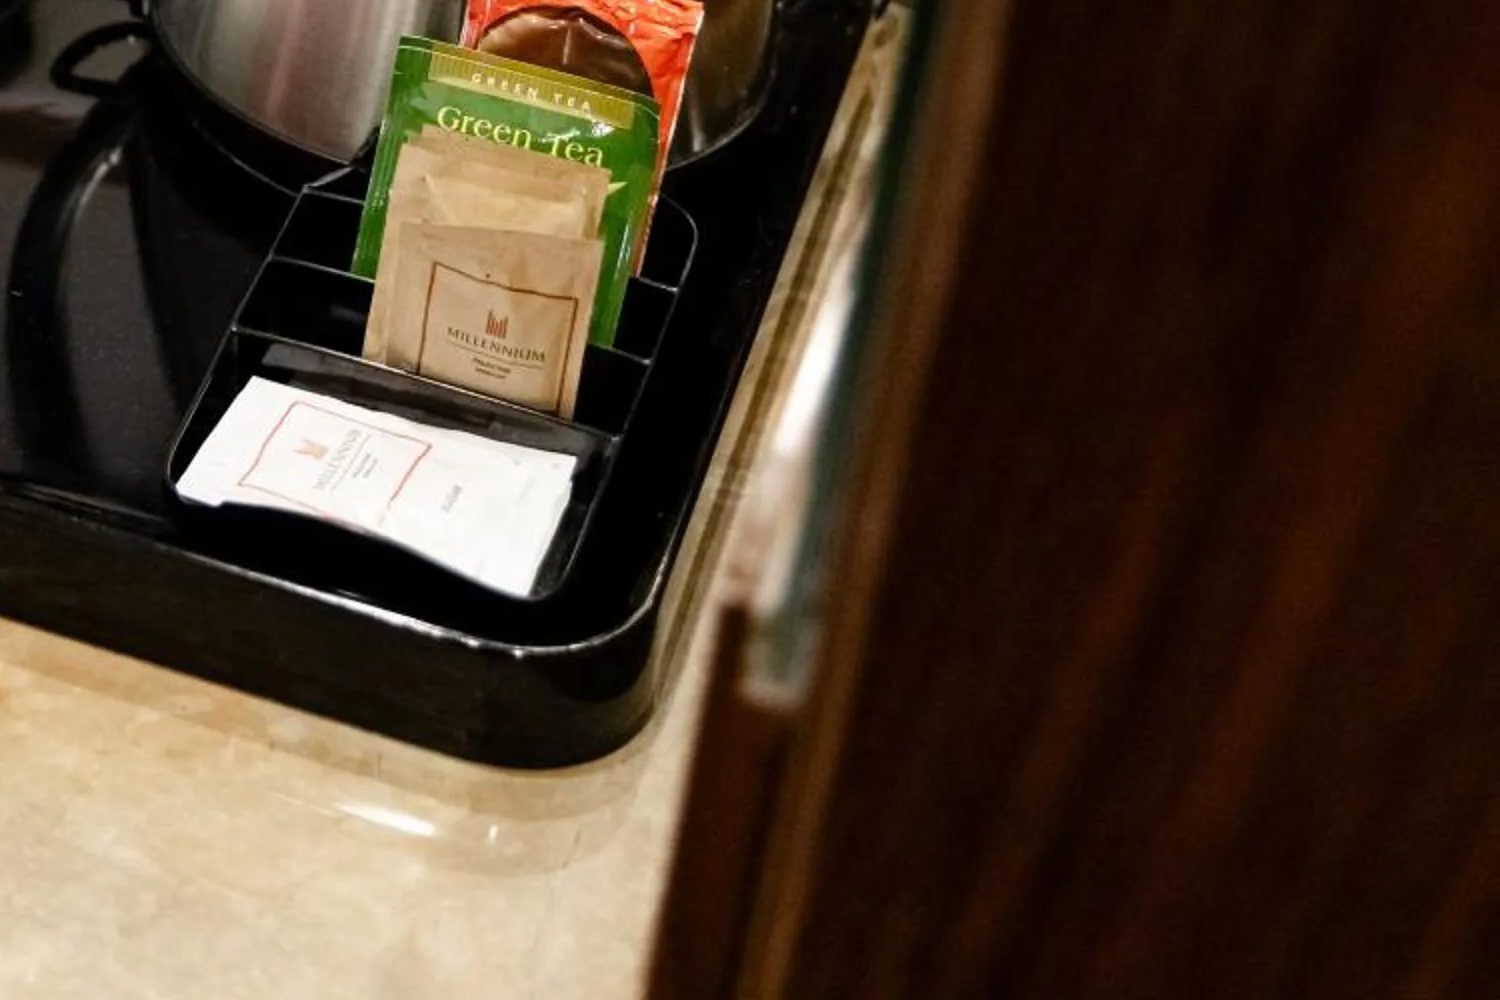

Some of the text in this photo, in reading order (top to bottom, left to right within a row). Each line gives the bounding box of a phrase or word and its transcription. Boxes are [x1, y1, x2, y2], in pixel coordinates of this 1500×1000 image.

[471, 72, 595, 116] GREEN TEA
[437, 105, 604, 168] Green Tea
[447, 326, 546, 362] MILLENNIUM
